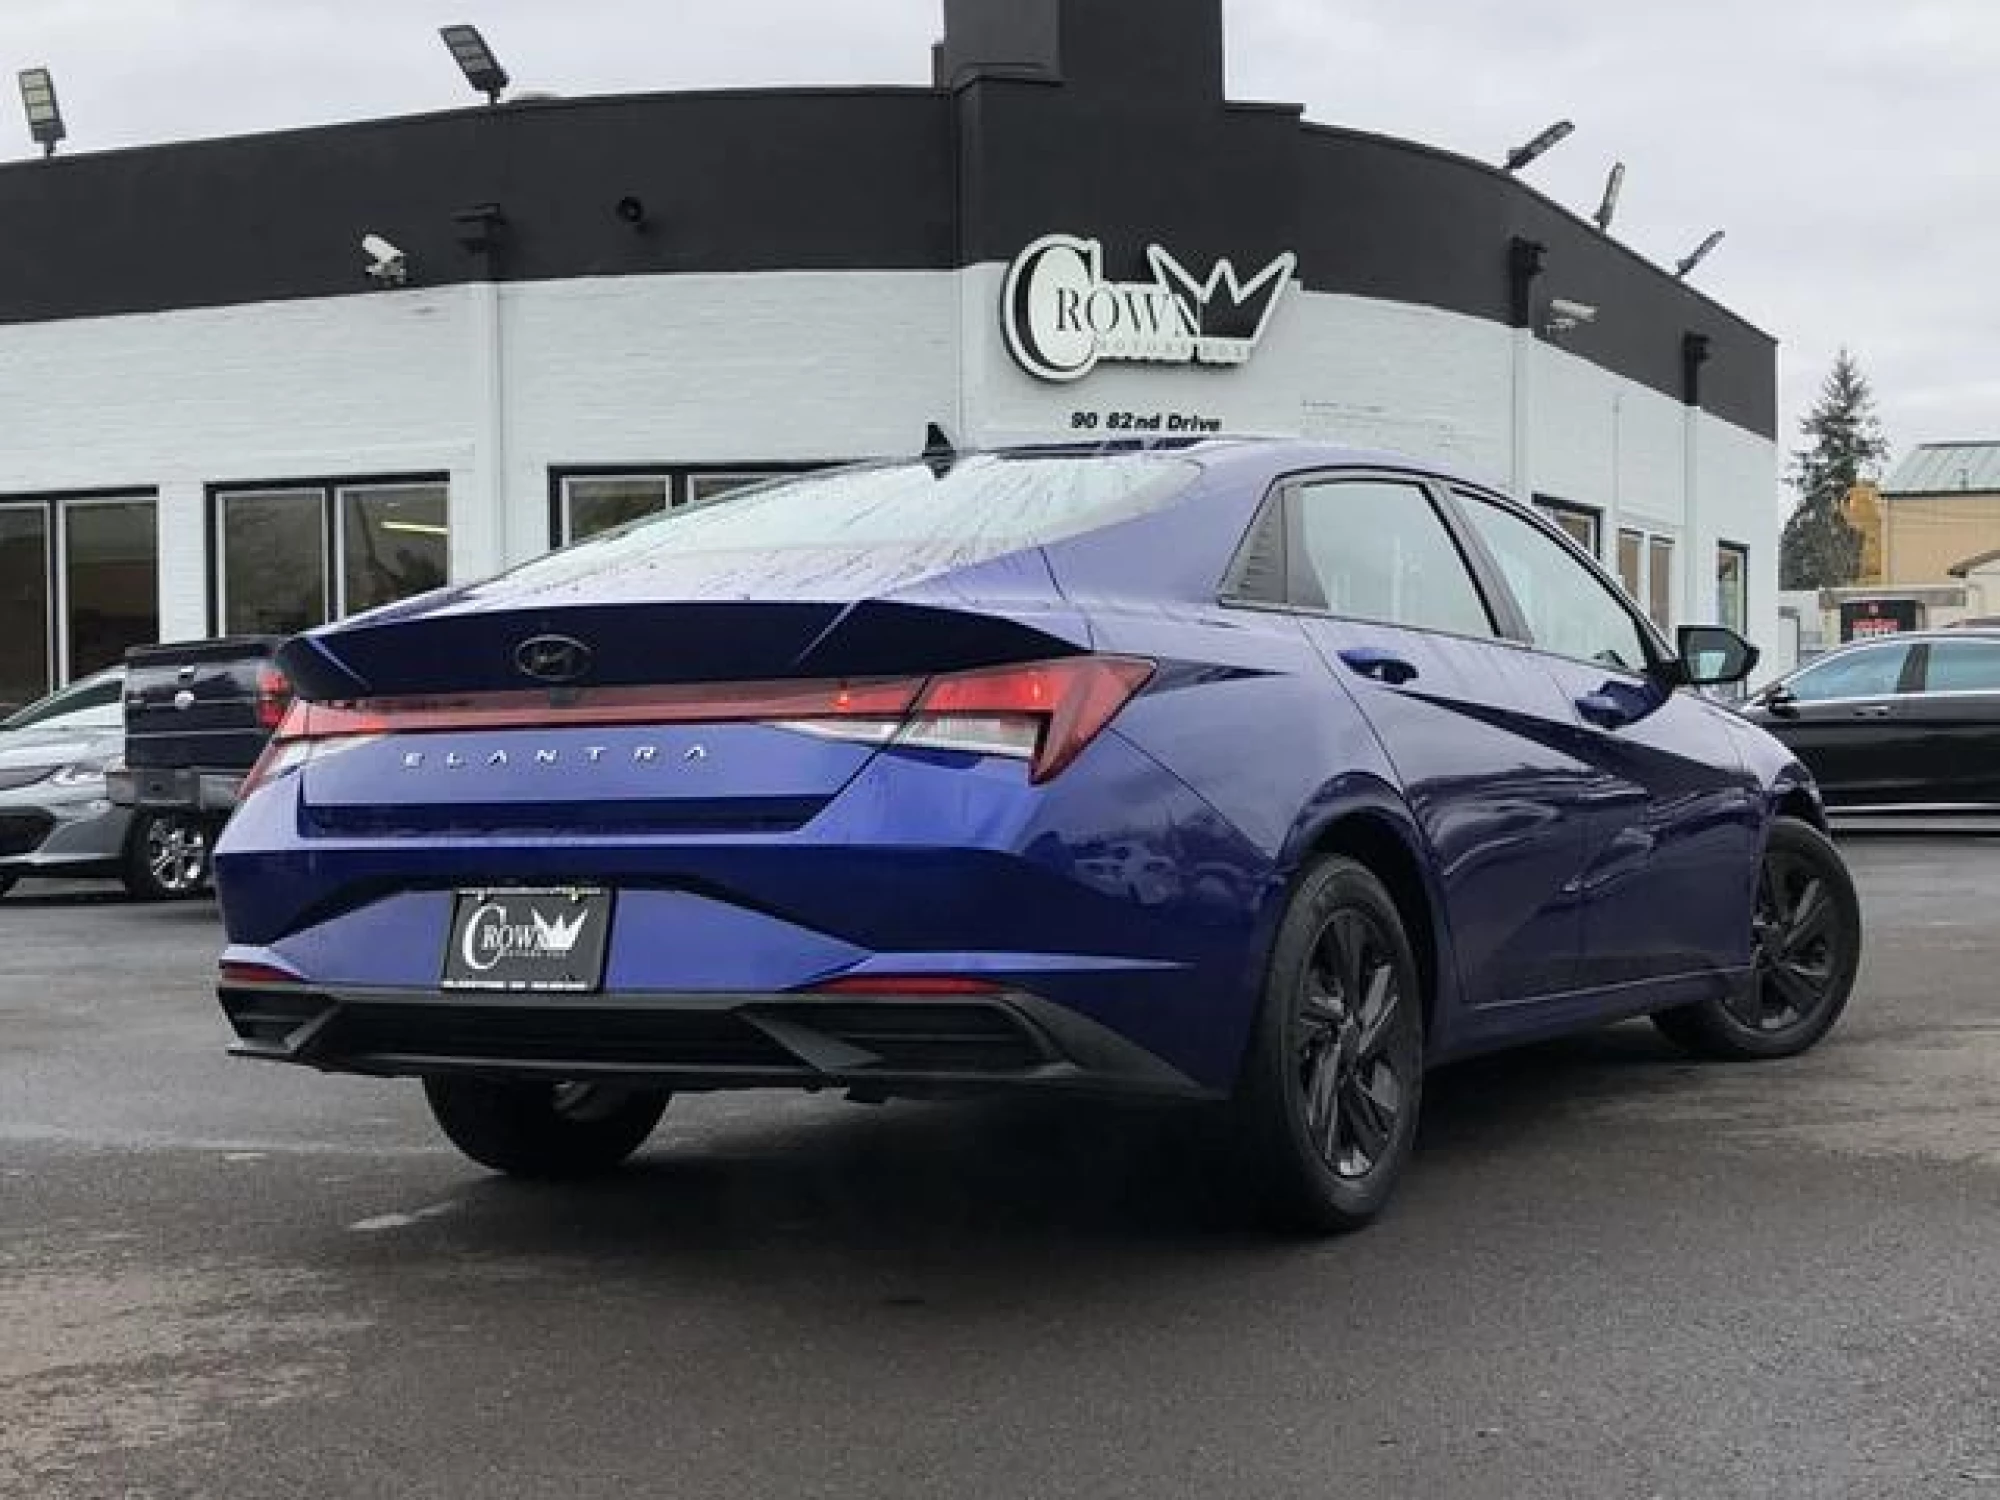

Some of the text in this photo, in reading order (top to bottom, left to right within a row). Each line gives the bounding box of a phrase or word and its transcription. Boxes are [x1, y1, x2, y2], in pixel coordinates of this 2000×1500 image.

[1008, 238, 1200, 376] CROWN
[1168, 414, 1223, 432] Drive
[403, 744, 708, 768] ELANTRA
